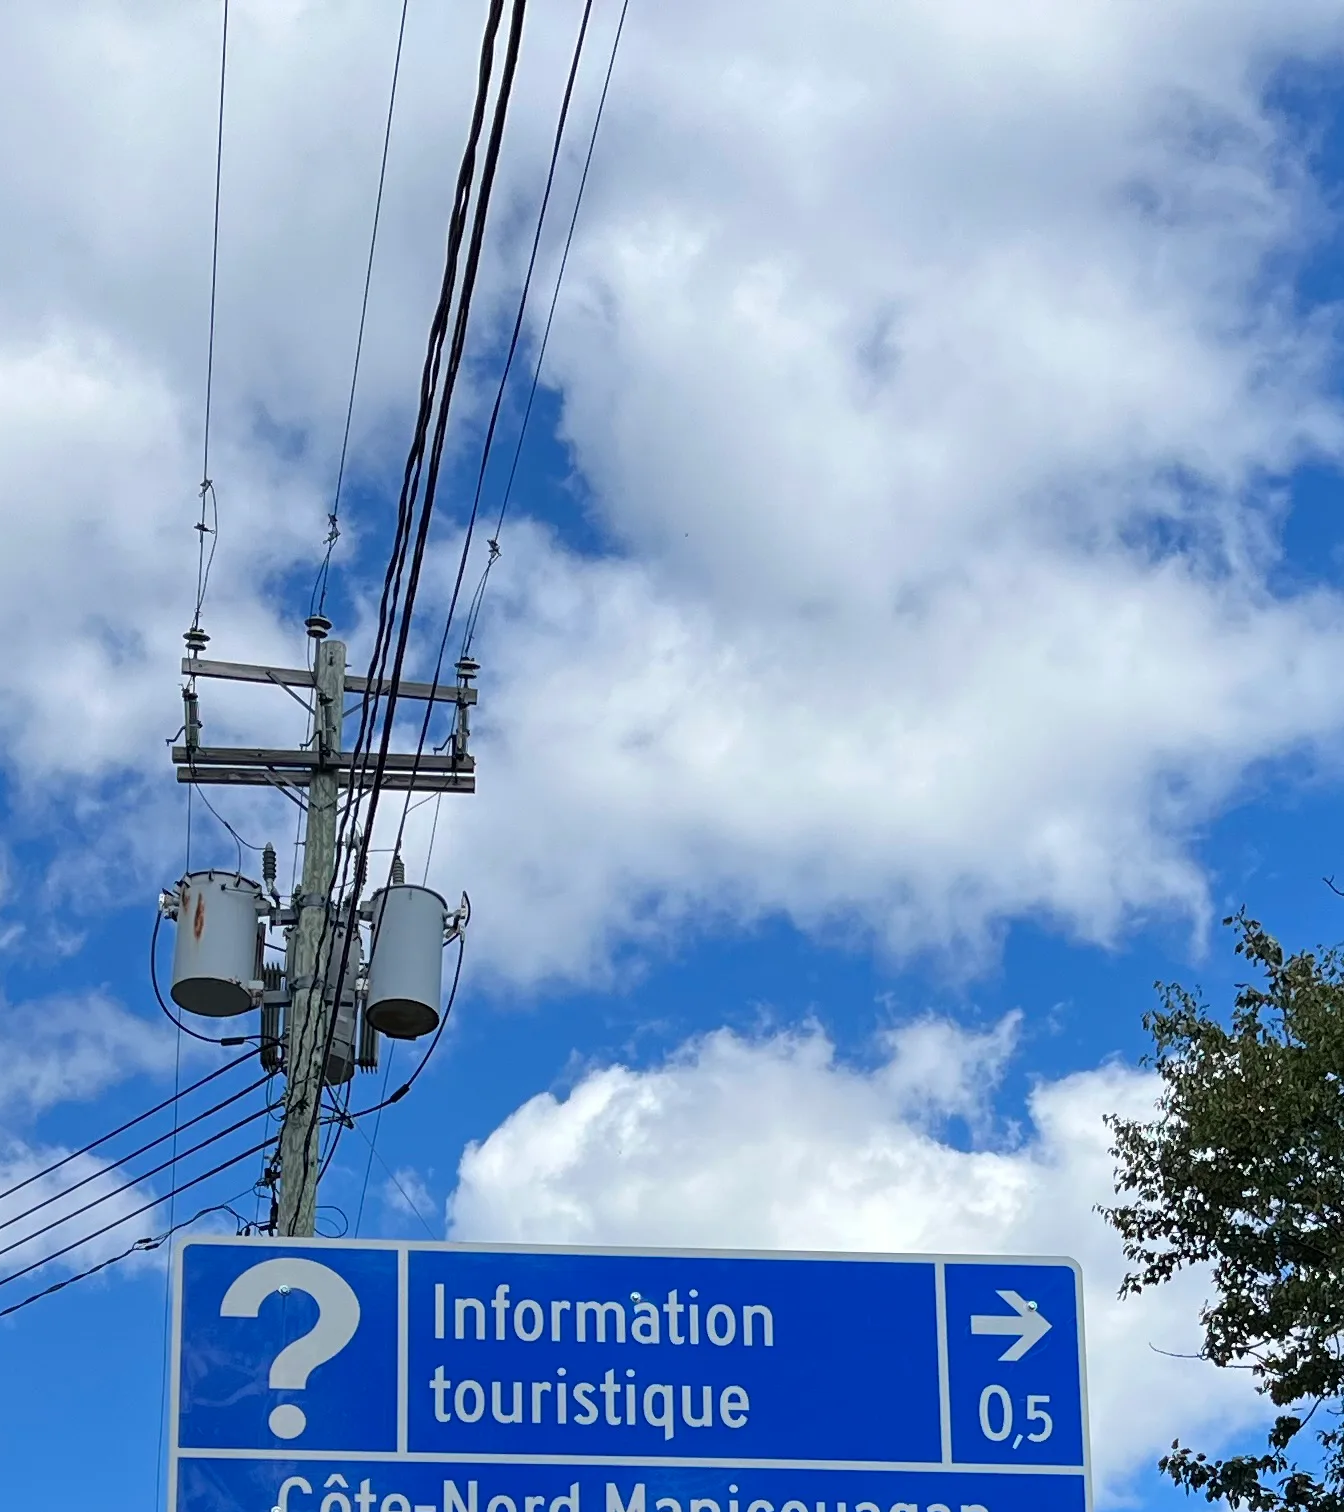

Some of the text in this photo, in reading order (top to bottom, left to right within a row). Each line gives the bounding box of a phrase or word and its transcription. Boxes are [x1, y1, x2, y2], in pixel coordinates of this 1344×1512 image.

[434, 1283, 775, 1348] Information
[429, 1366, 750, 1440] touristique
[979, 1384, 1053, 1450] 0,5
